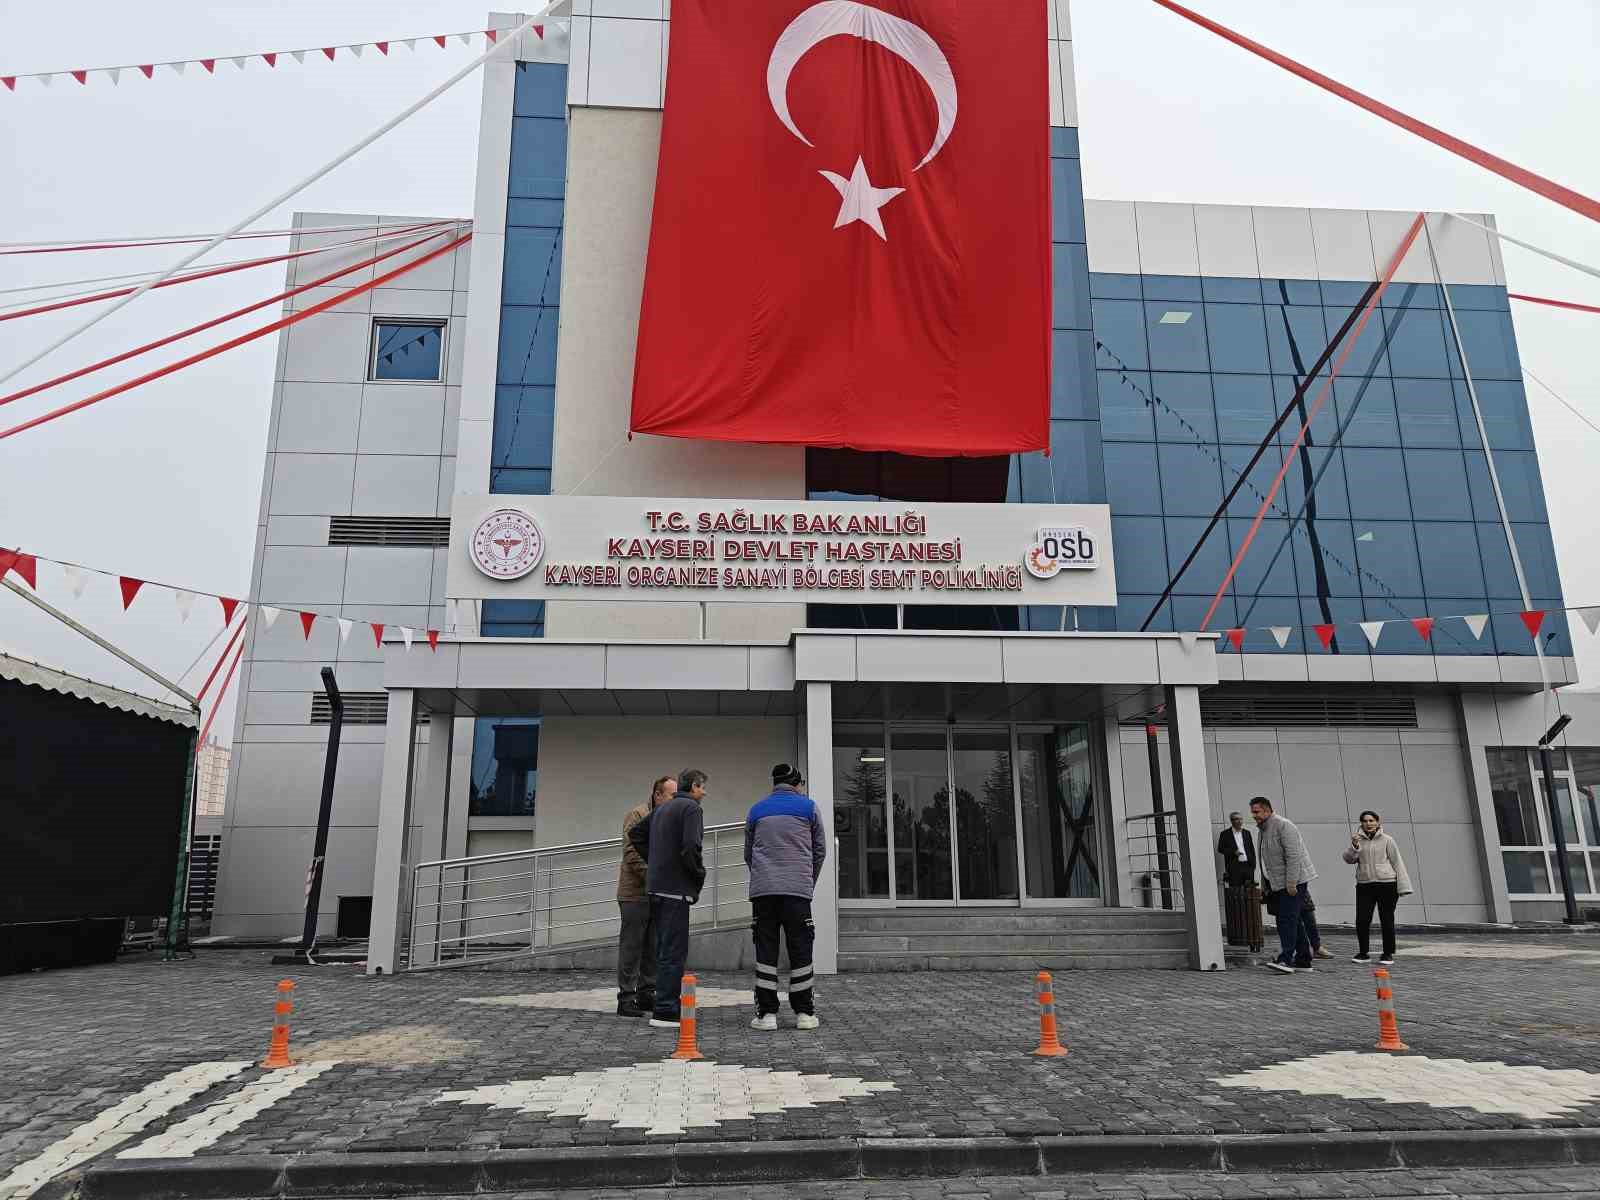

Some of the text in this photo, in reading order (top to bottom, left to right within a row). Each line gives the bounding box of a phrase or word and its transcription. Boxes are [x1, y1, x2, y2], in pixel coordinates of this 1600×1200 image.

[647, 509, 926, 535] T.C. SAĞLIK BAKANLIĞI
[608, 535, 962, 562] KAYSERİ DEVLET HASTANESİ
[545, 561, 1022, 590] KAYSERİ ORGANİZE SANAYİ BÖLGESİ SEMT POLİKLİNİĞİ
